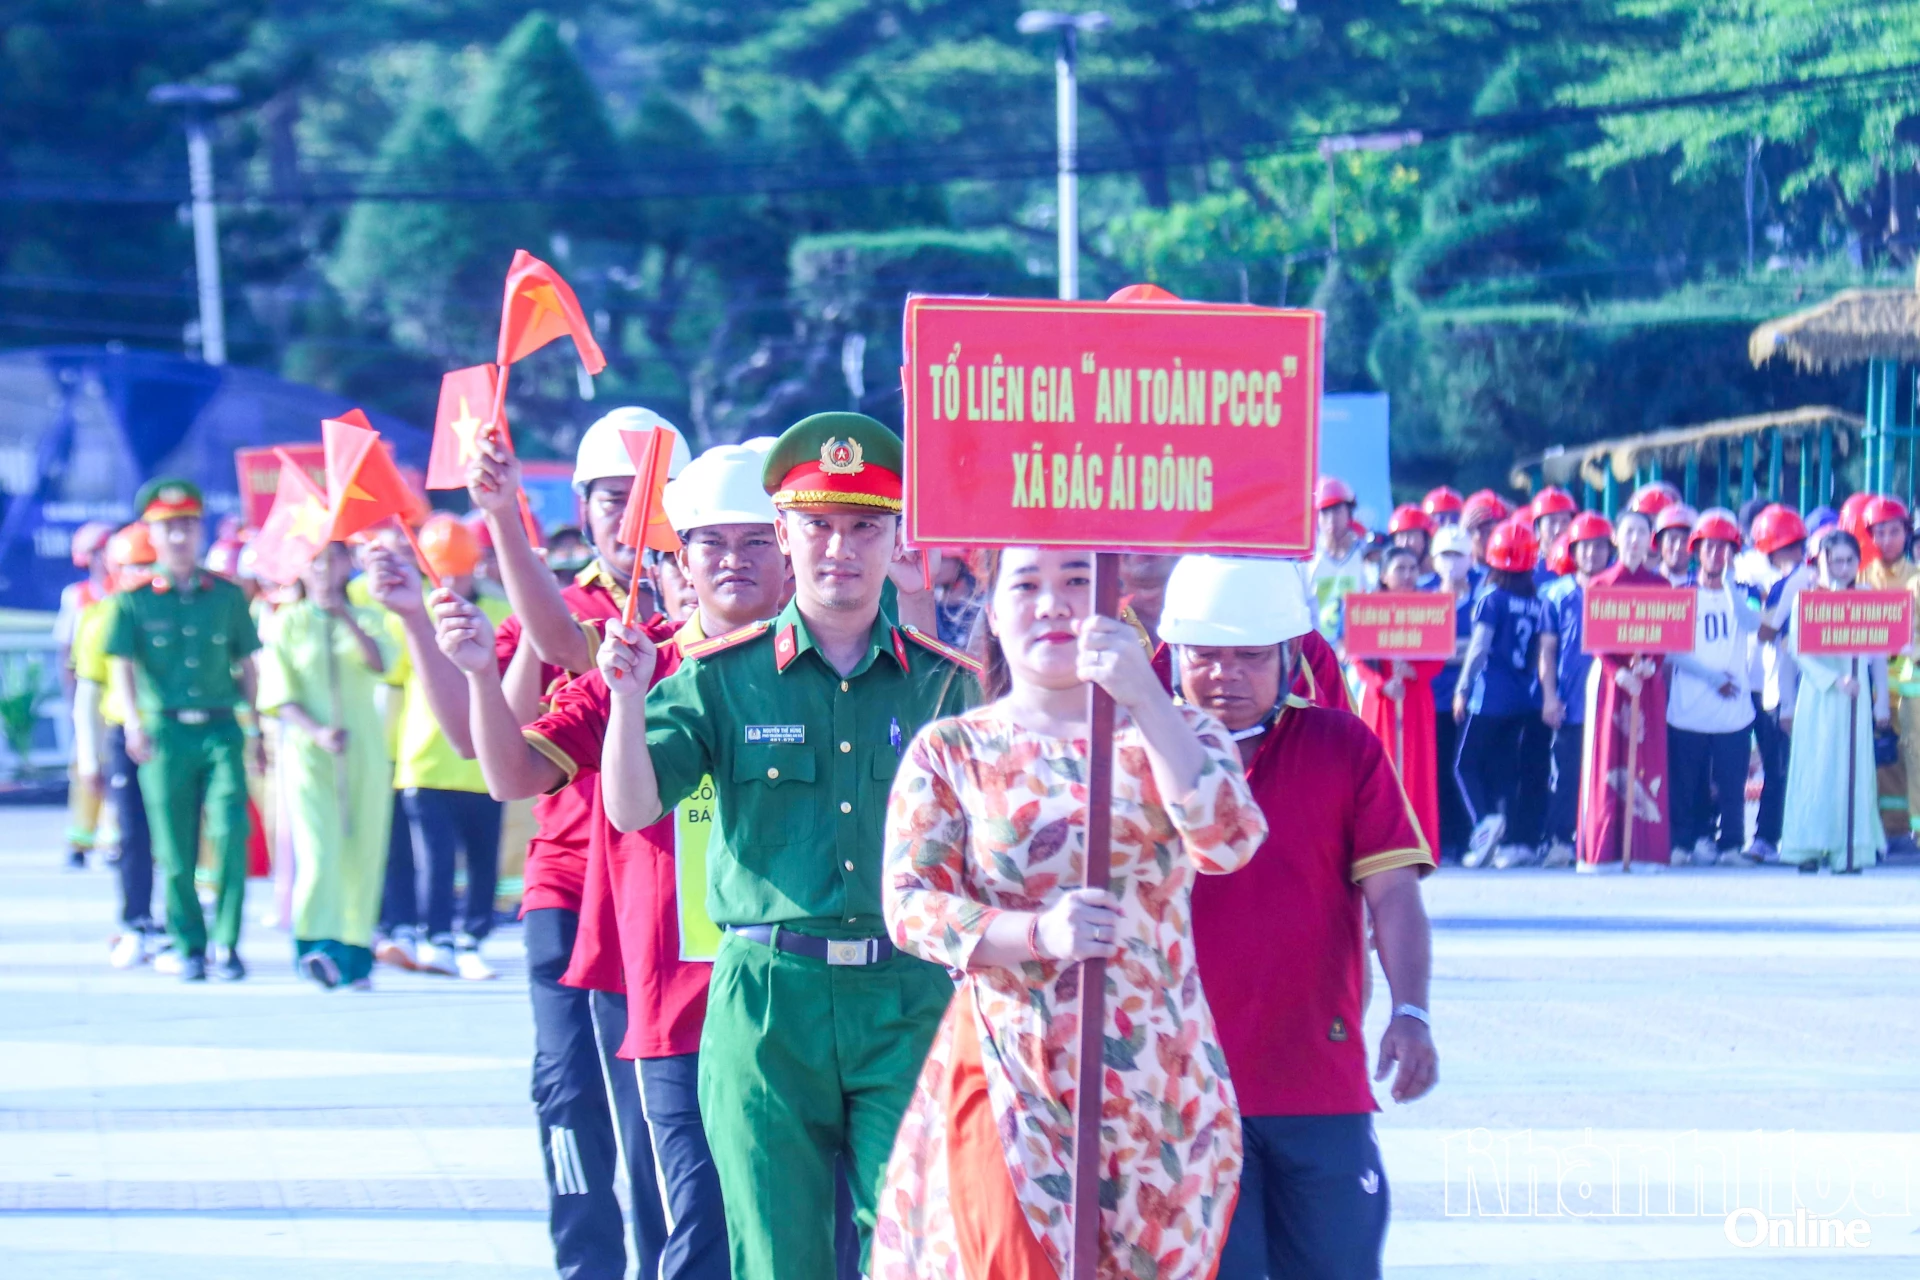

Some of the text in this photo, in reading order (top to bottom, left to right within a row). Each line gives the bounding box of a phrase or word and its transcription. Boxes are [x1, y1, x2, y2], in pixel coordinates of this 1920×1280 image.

[929, 342, 961, 422] TỔ
[967, 353, 1025, 422] LIÊN
[1031, 366, 1075, 423] GIA
[1137, 356, 1206, 425] TOÀN
[1011, 442, 1214, 512] XÃ BÁC ÁI ĐÔNG
[1705, 612, 1728, 641] 01
